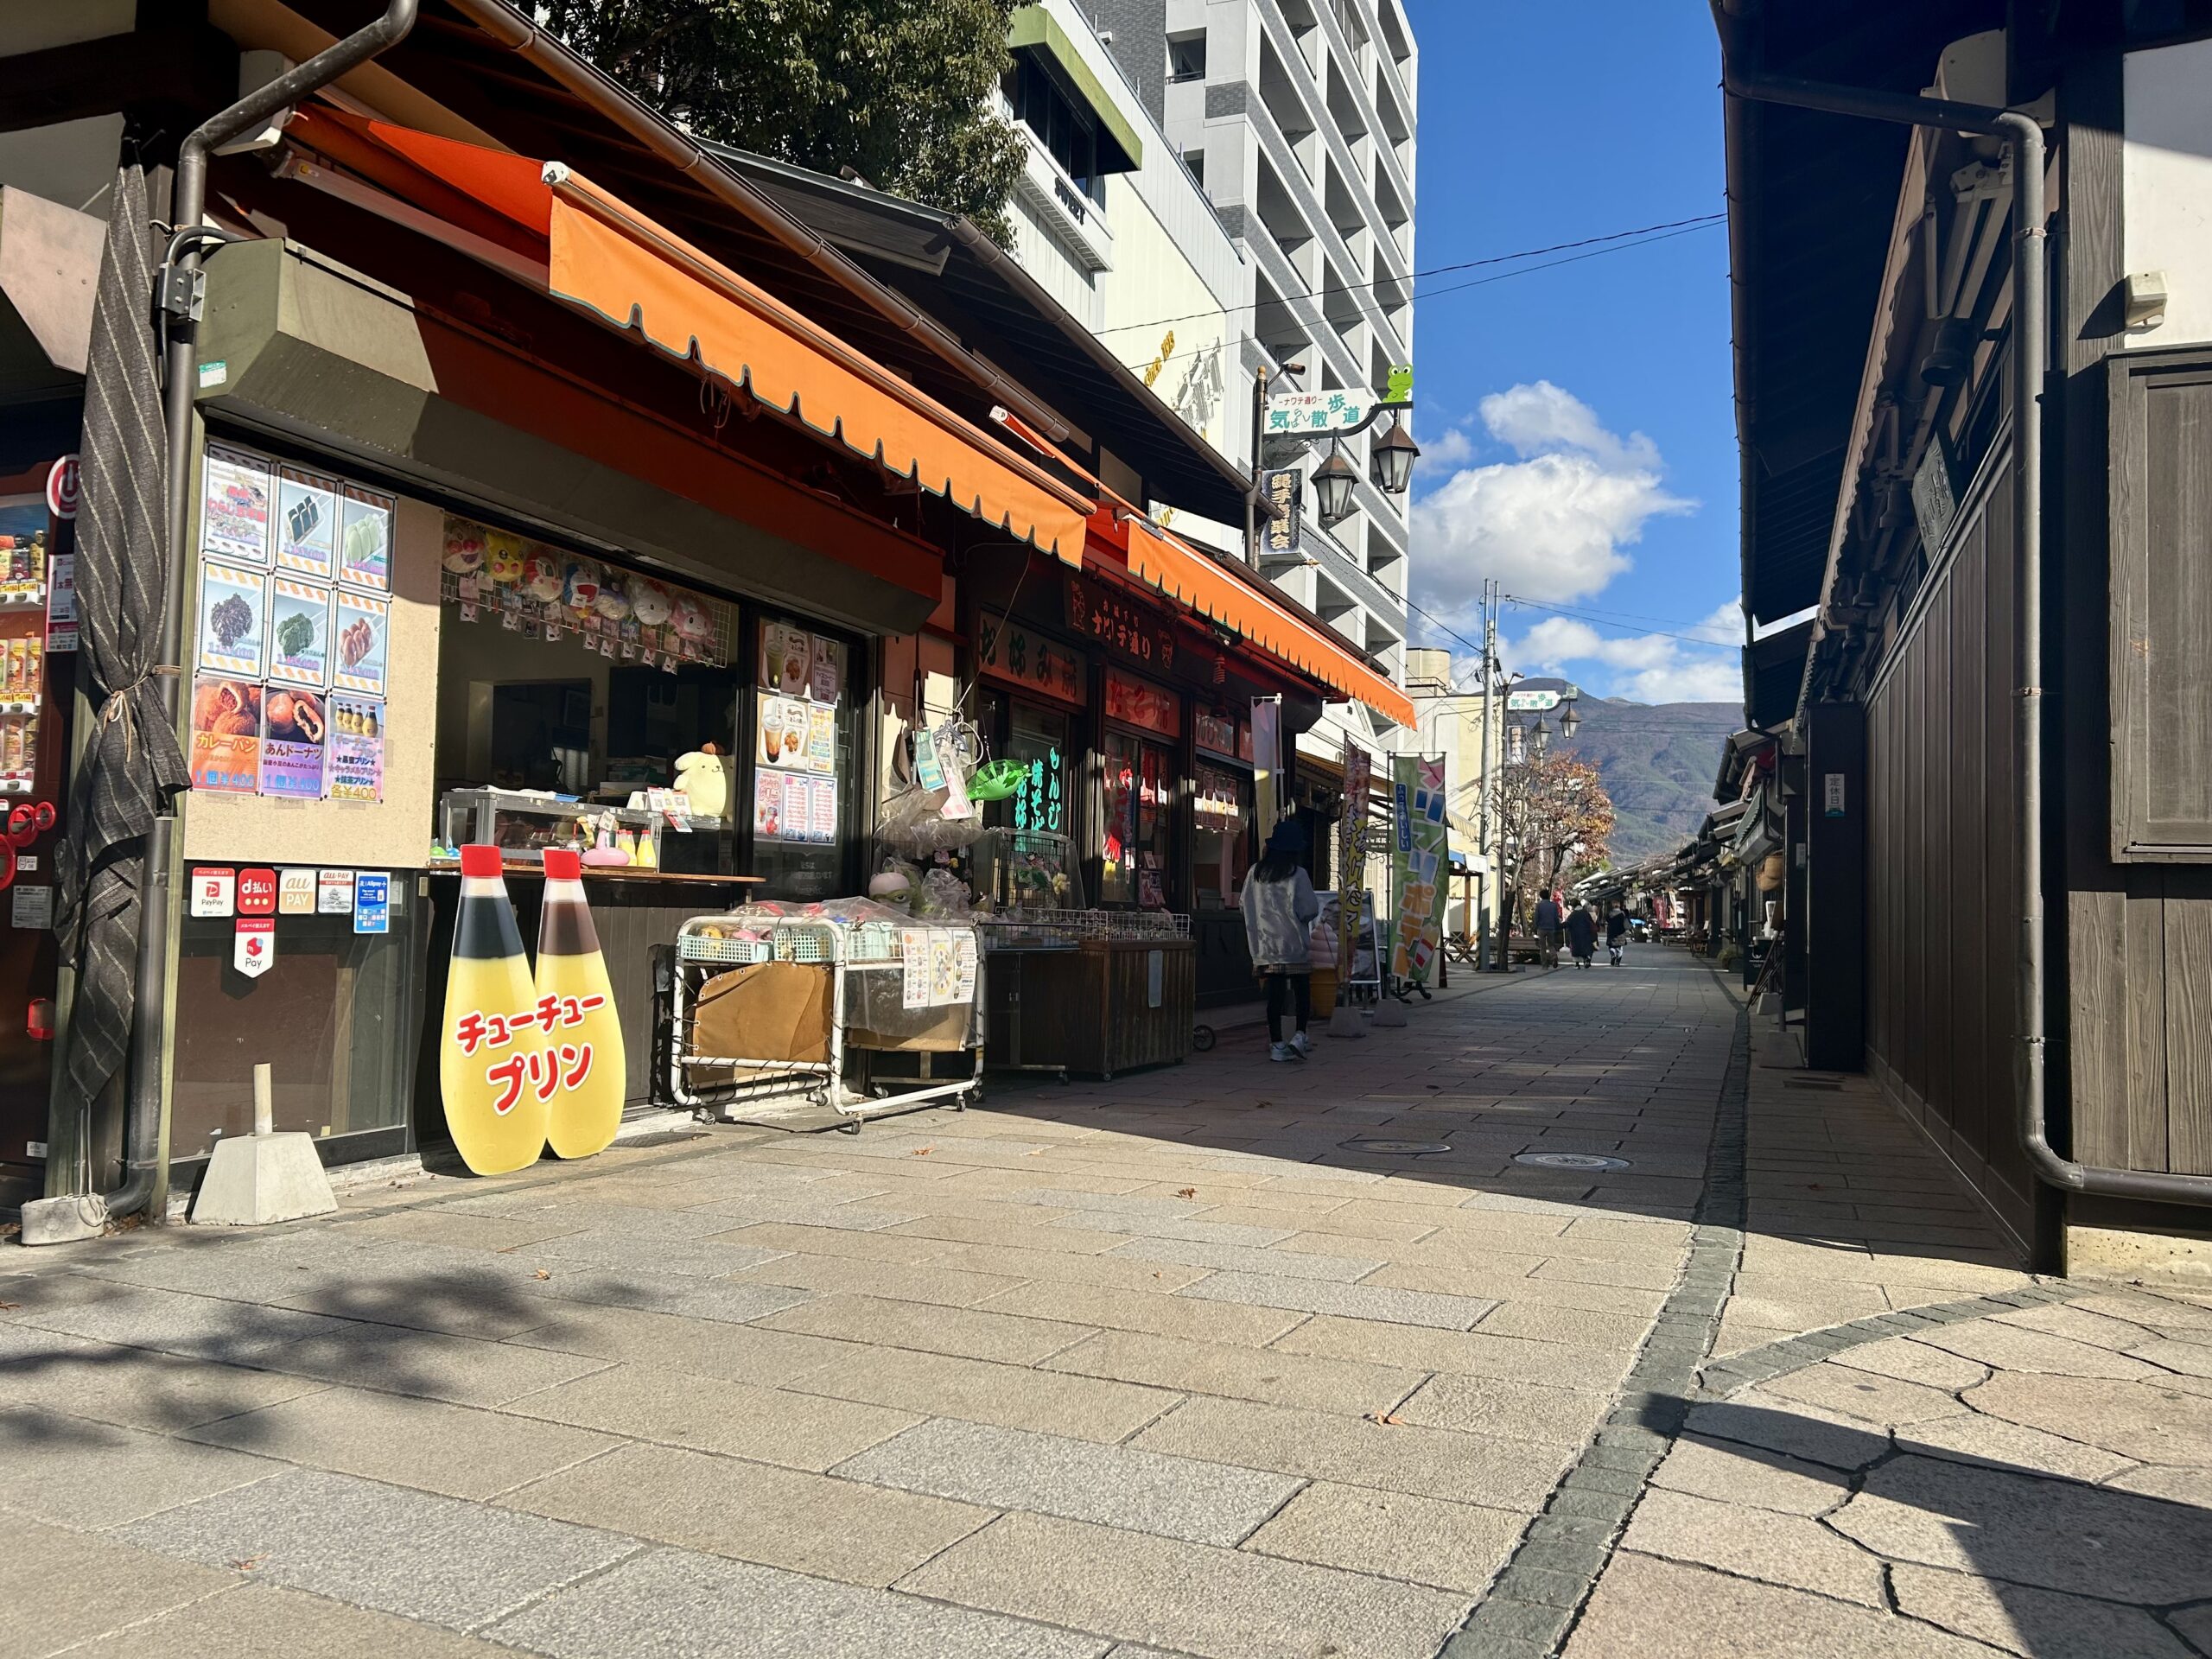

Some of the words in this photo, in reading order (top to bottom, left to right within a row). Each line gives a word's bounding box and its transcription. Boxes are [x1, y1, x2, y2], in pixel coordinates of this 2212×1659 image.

[265, 743, 323, 760] あんドーナツ
[1829, 779, 1841, 804] 定休日
[241, 878, 272, 894] d払い
[285, 877, 309, 890] au
[286, 893, 309, 906] PAY
[245, 957, 263, 969] Pay
[456, 995, 604, 1053] チューチュー
[488, 1046, 591, 1112] プリン
